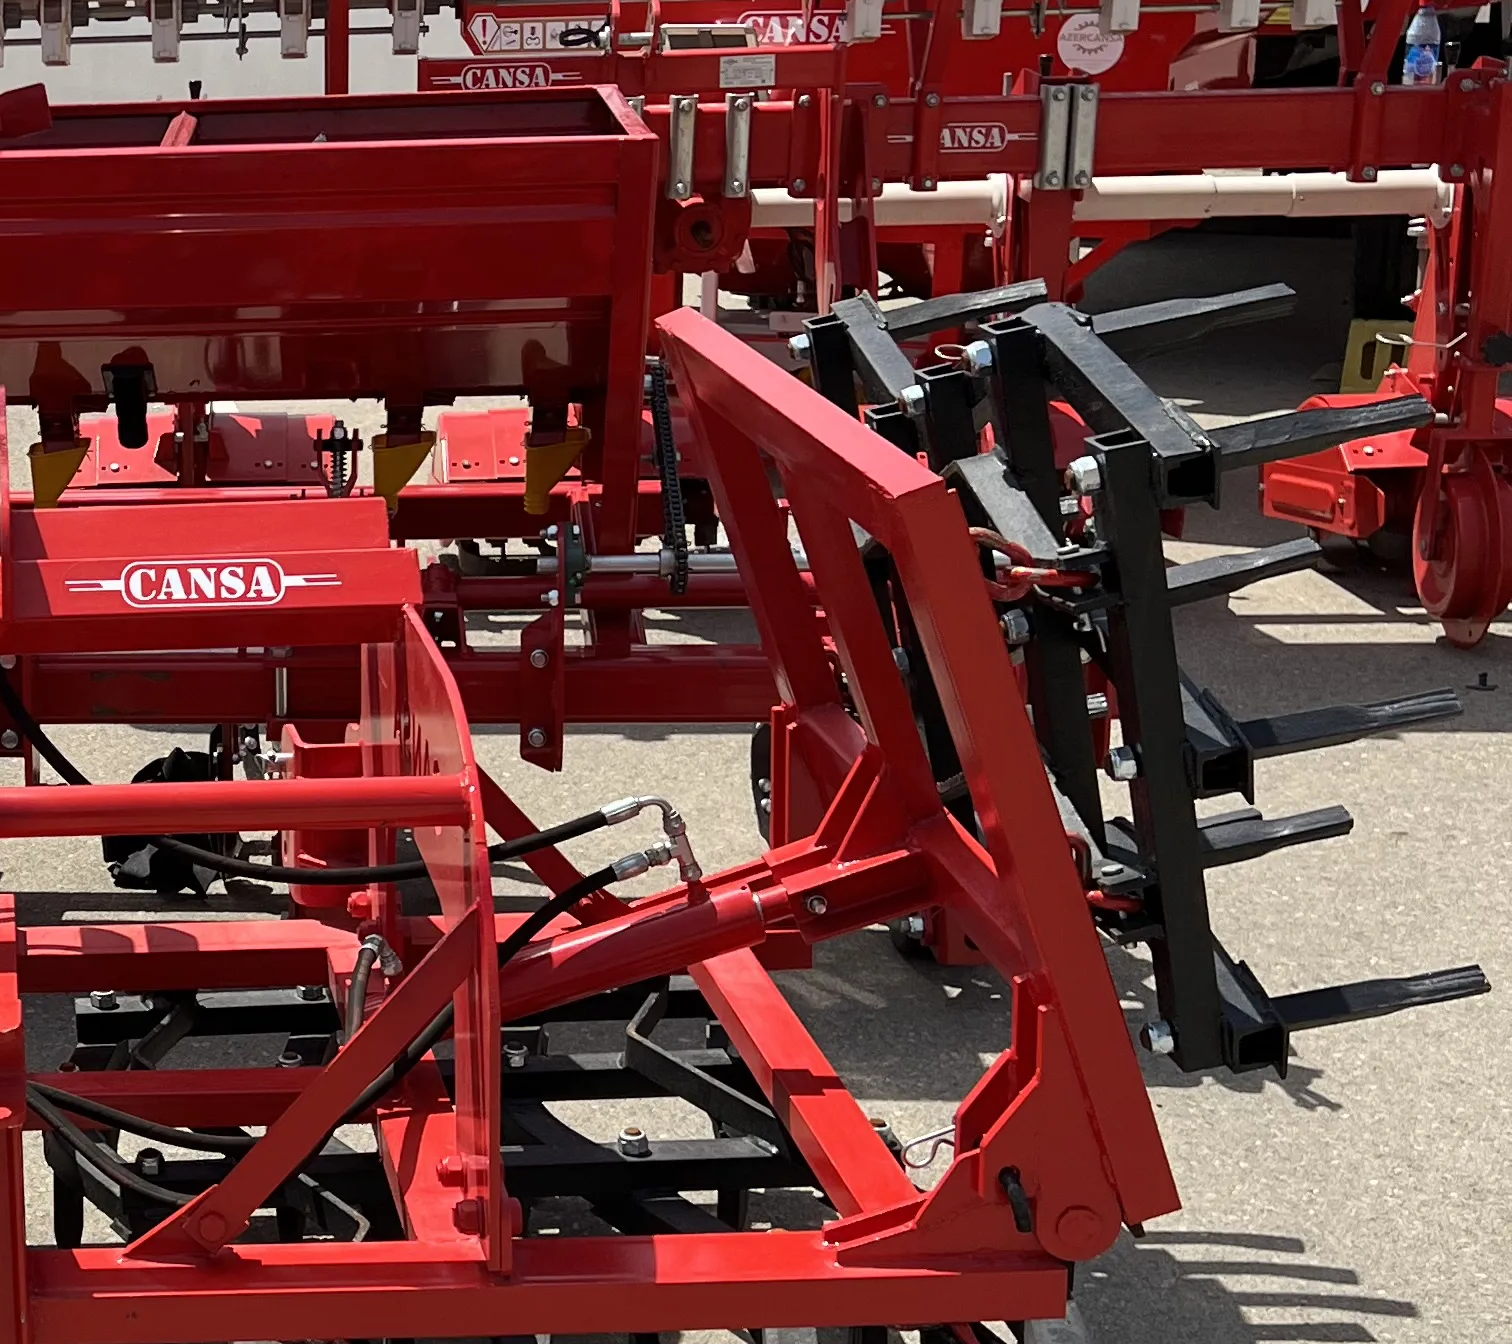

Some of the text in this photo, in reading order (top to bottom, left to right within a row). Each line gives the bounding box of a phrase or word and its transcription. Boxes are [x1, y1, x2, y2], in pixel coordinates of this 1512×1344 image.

[464, 67, 548, 90] CANSA
[941, 127, 1003, 148] ANSA
[128, 565, 277, 601] CANSA
